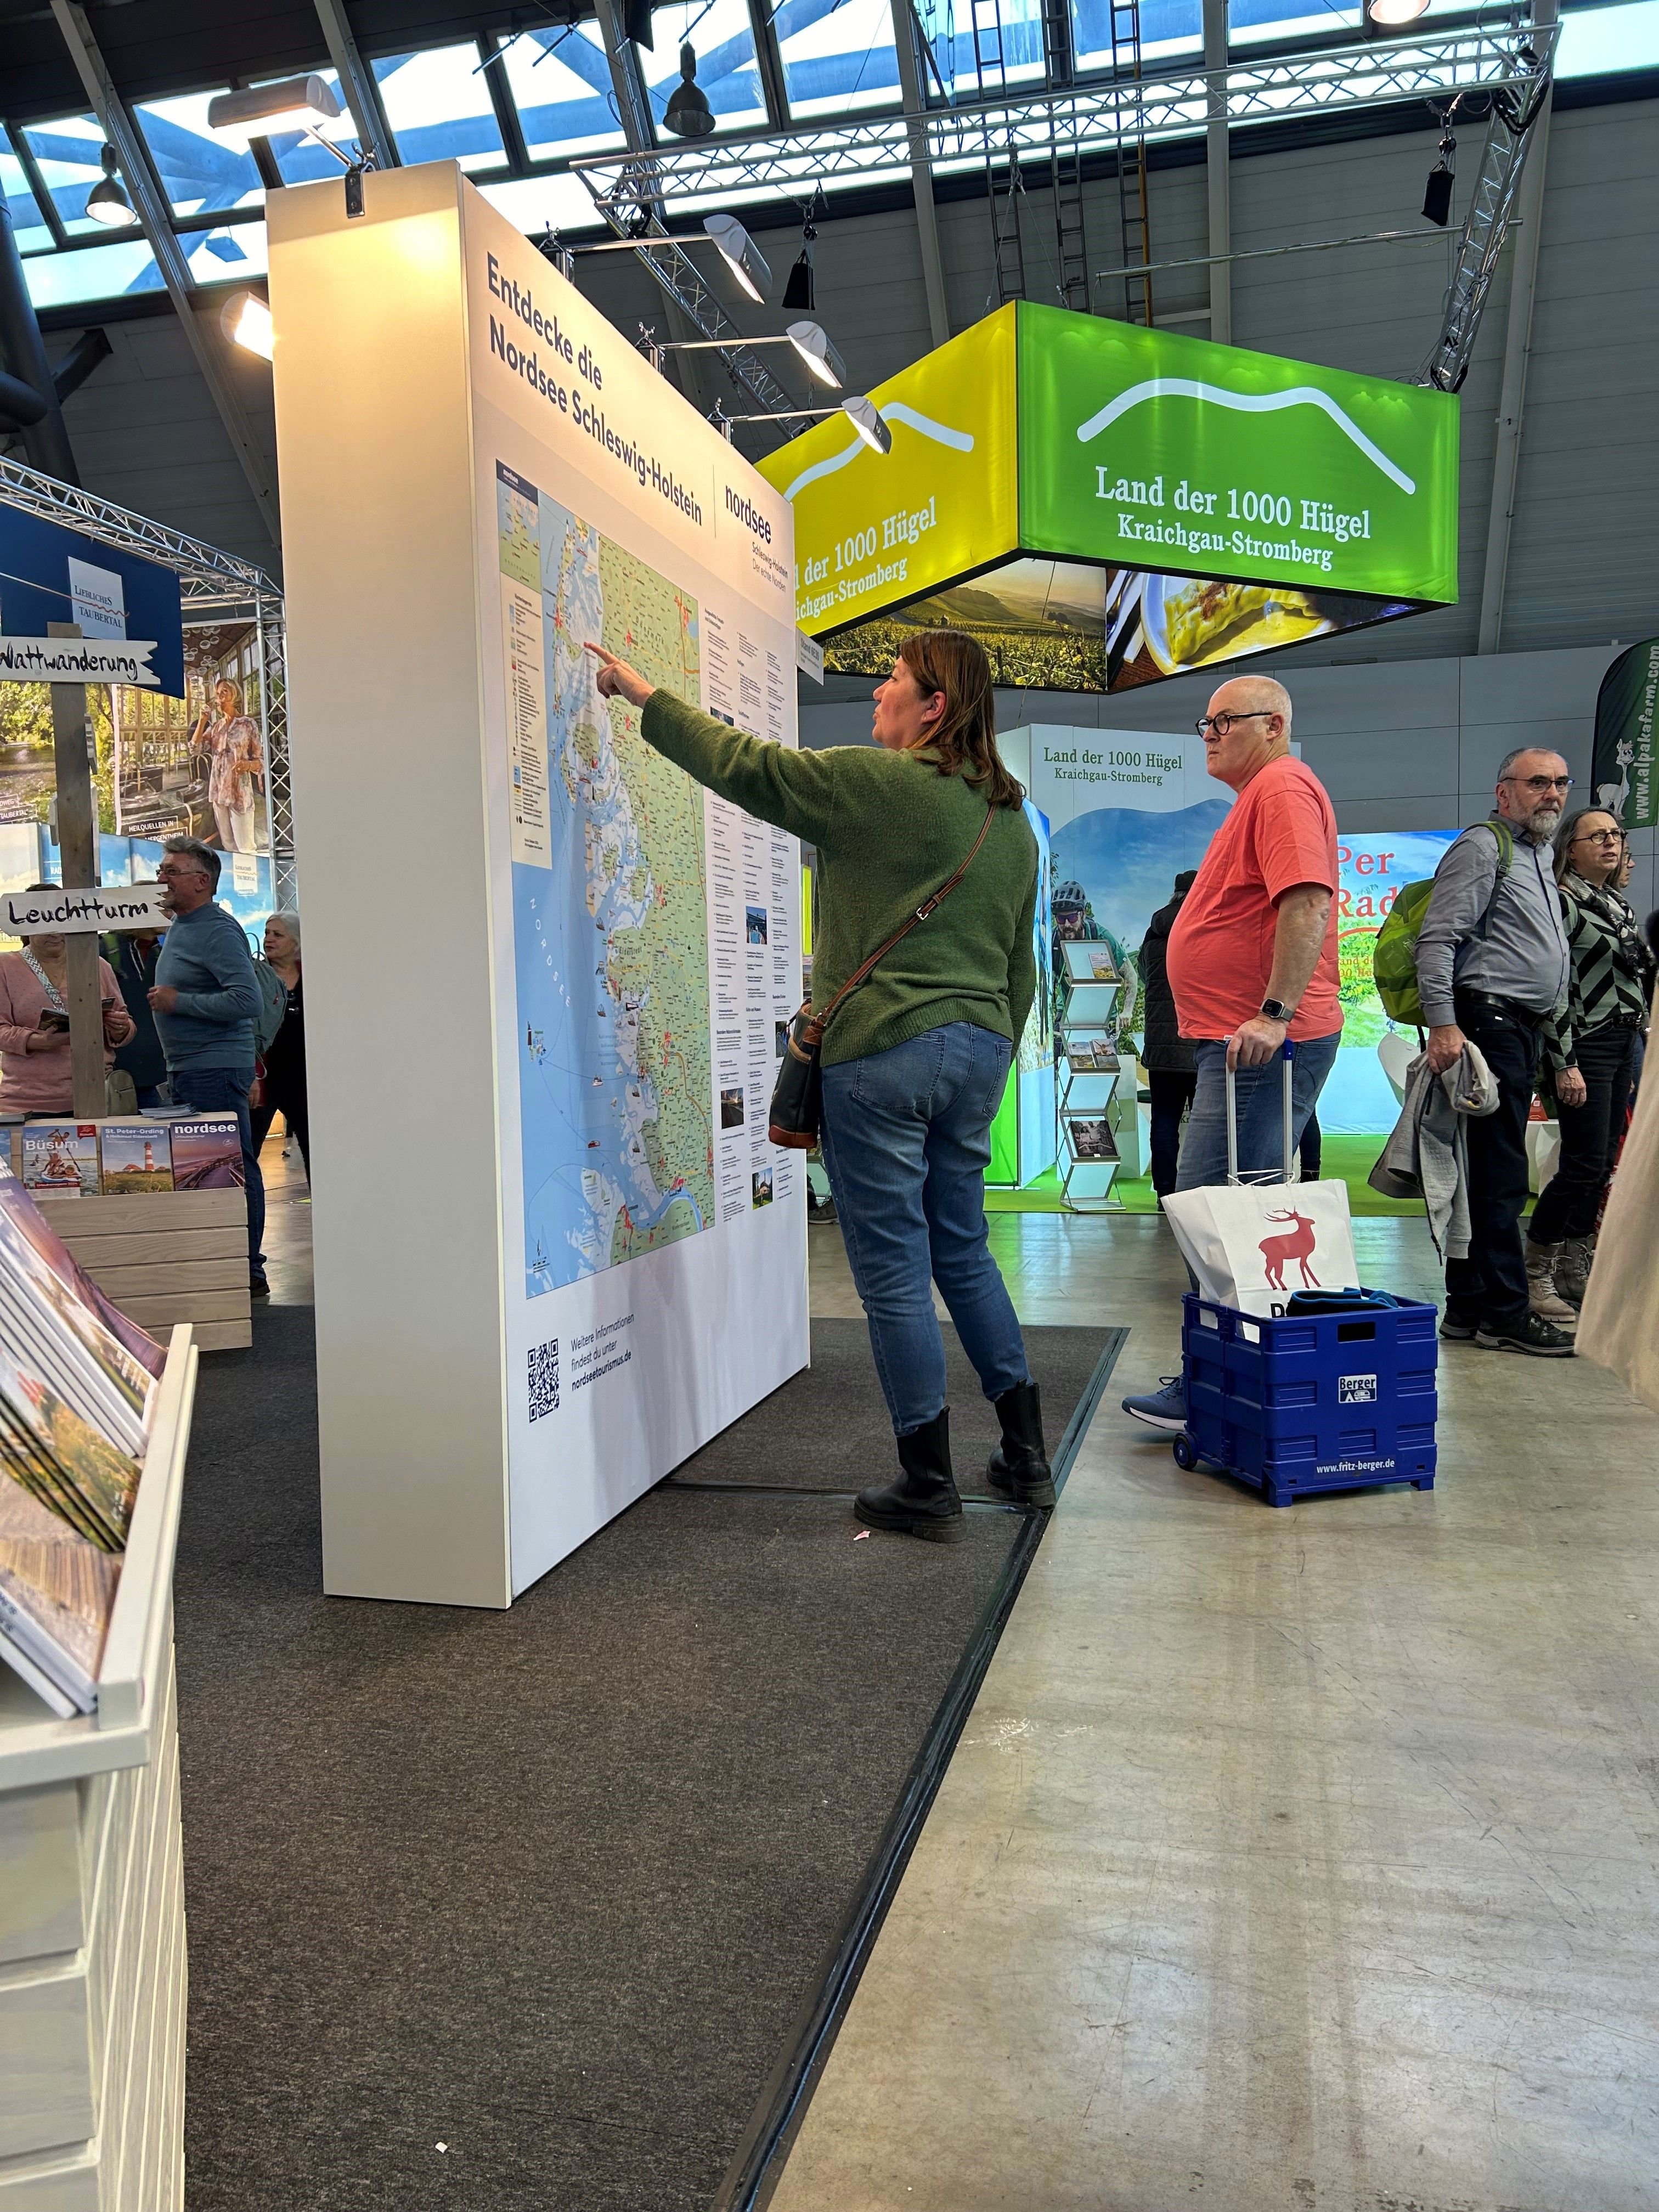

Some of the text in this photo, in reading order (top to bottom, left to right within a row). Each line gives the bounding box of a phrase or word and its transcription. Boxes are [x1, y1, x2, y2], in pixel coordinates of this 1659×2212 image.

[487, 251, 602, 391] Entdecke die
[489, 314, 703, 527] Nordsee Schleswig-Holstein
[726, 484, 771, 544] nordsee
[1095, 465, 1372, 541] Land der 1000 Hügel
[804, 556, 830, 586] der
[835, 526, 877, 572] 1000
[882, 495, 936, 550] Hügel
[1118, 512, 1333, 572] Kraichgau-Stromberg
[752, 541, 788, 579] Schleswig-Holstein
[761, 566, 771, 583] echte
[772, 572, 787, 594] Norden
[795, 557, 908, 621] ichgau-Stromberg
[74, 585, 112, 606] LIEBLICHES
[78, 606, 123, 629] TAUBERTAL
[1633, 645, 1659, 820] www.alpakafarm.com
[1043, 747, 1183, 771] Land der 1000 Hügel
[1054, 768, 1163, 786] Kraichgau-Stromberg
[128, 822, 167, 832] HEILQUELLEN
[1338, 846, 1395, 876] Per
[8, 896, 149, 925] Leuchtturm
[1339, 953, 1359, 965] and
[117, 1127, 165, 1136] Peter-Ording
[174, 1124, 236, 1134] nordsee
[26, 1139, 78, 1150] Büsum
[1271, 1303, 1285, 1318] D
[571, 1313, 635, 1352] Weitere Informationen
[571, 1339, 618, 1372] findest du unter
[572, 1348, 632, 1392] nordseetourismus.de
[1340, 1378, 1375, 1390] Berger
[1317, 1458, 1395, 1474] www.fritz-berger.de
